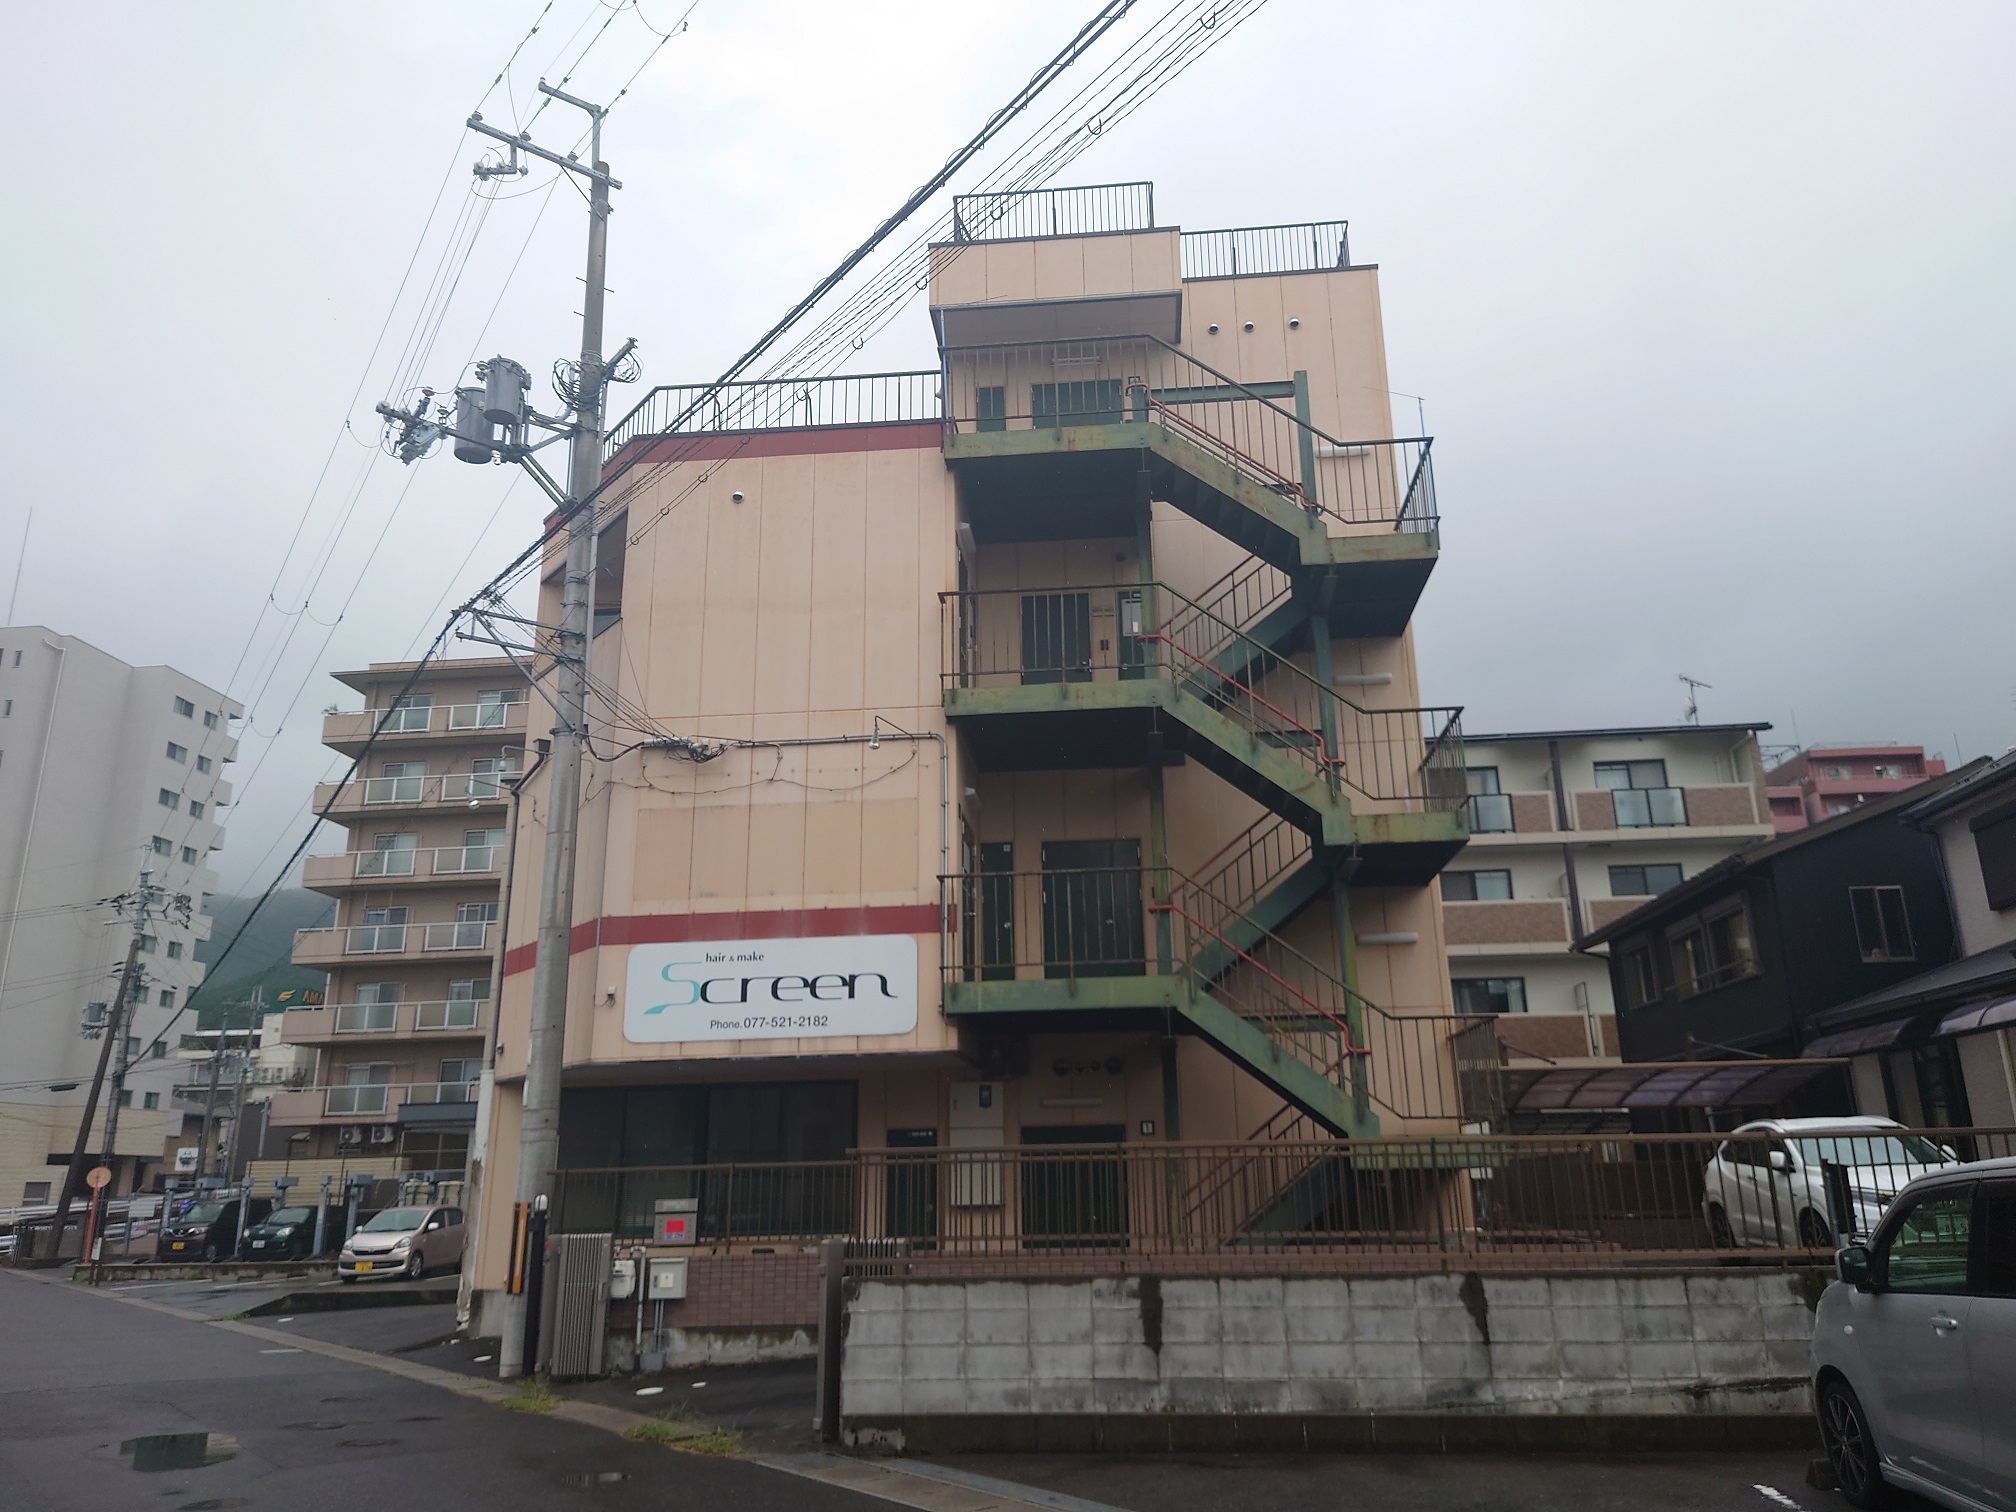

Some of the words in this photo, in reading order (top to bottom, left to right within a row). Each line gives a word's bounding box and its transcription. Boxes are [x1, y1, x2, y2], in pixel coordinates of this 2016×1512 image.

[705, 952, 726, 963] hair
[737, 951, 764, 962] make
[643, 961, 898, 1014] Screen
